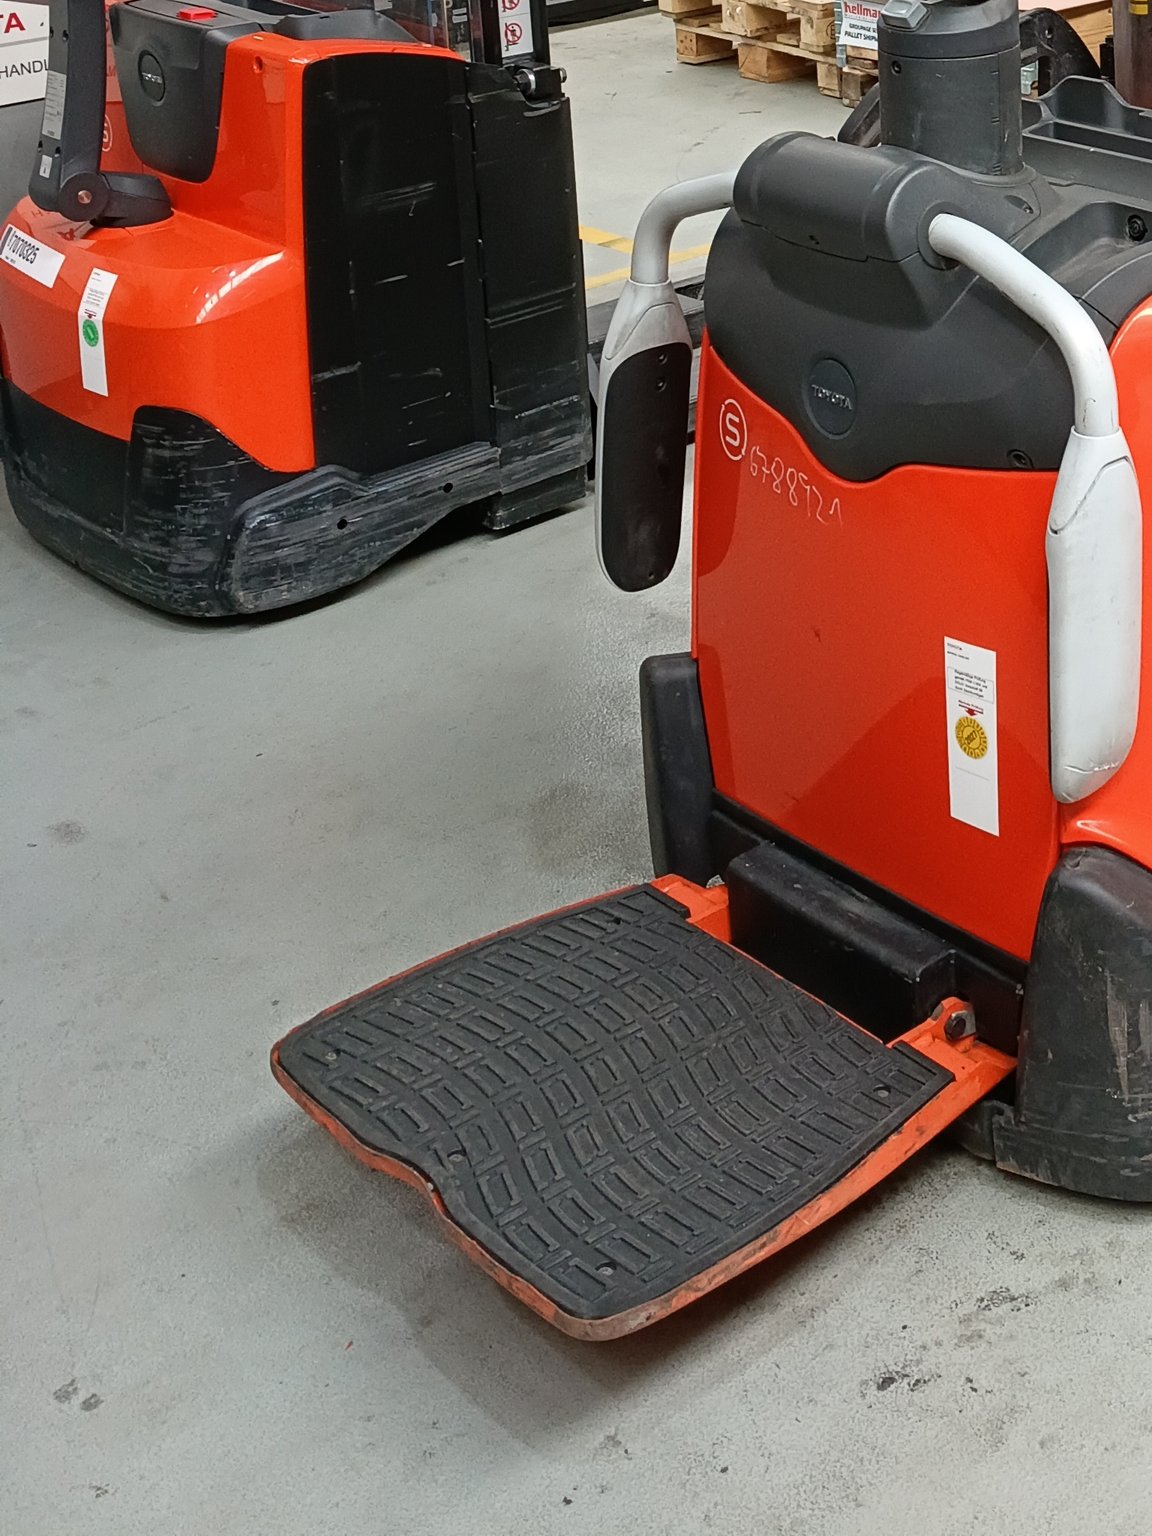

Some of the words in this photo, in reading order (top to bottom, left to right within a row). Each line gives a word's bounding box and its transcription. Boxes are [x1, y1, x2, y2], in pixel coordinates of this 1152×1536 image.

[0, 12, 25, 33] A
[9, 234, 39, 264] 7070325
[811, 384, 852, 410] TOYOTA
[725, 412, 740, 447] S
